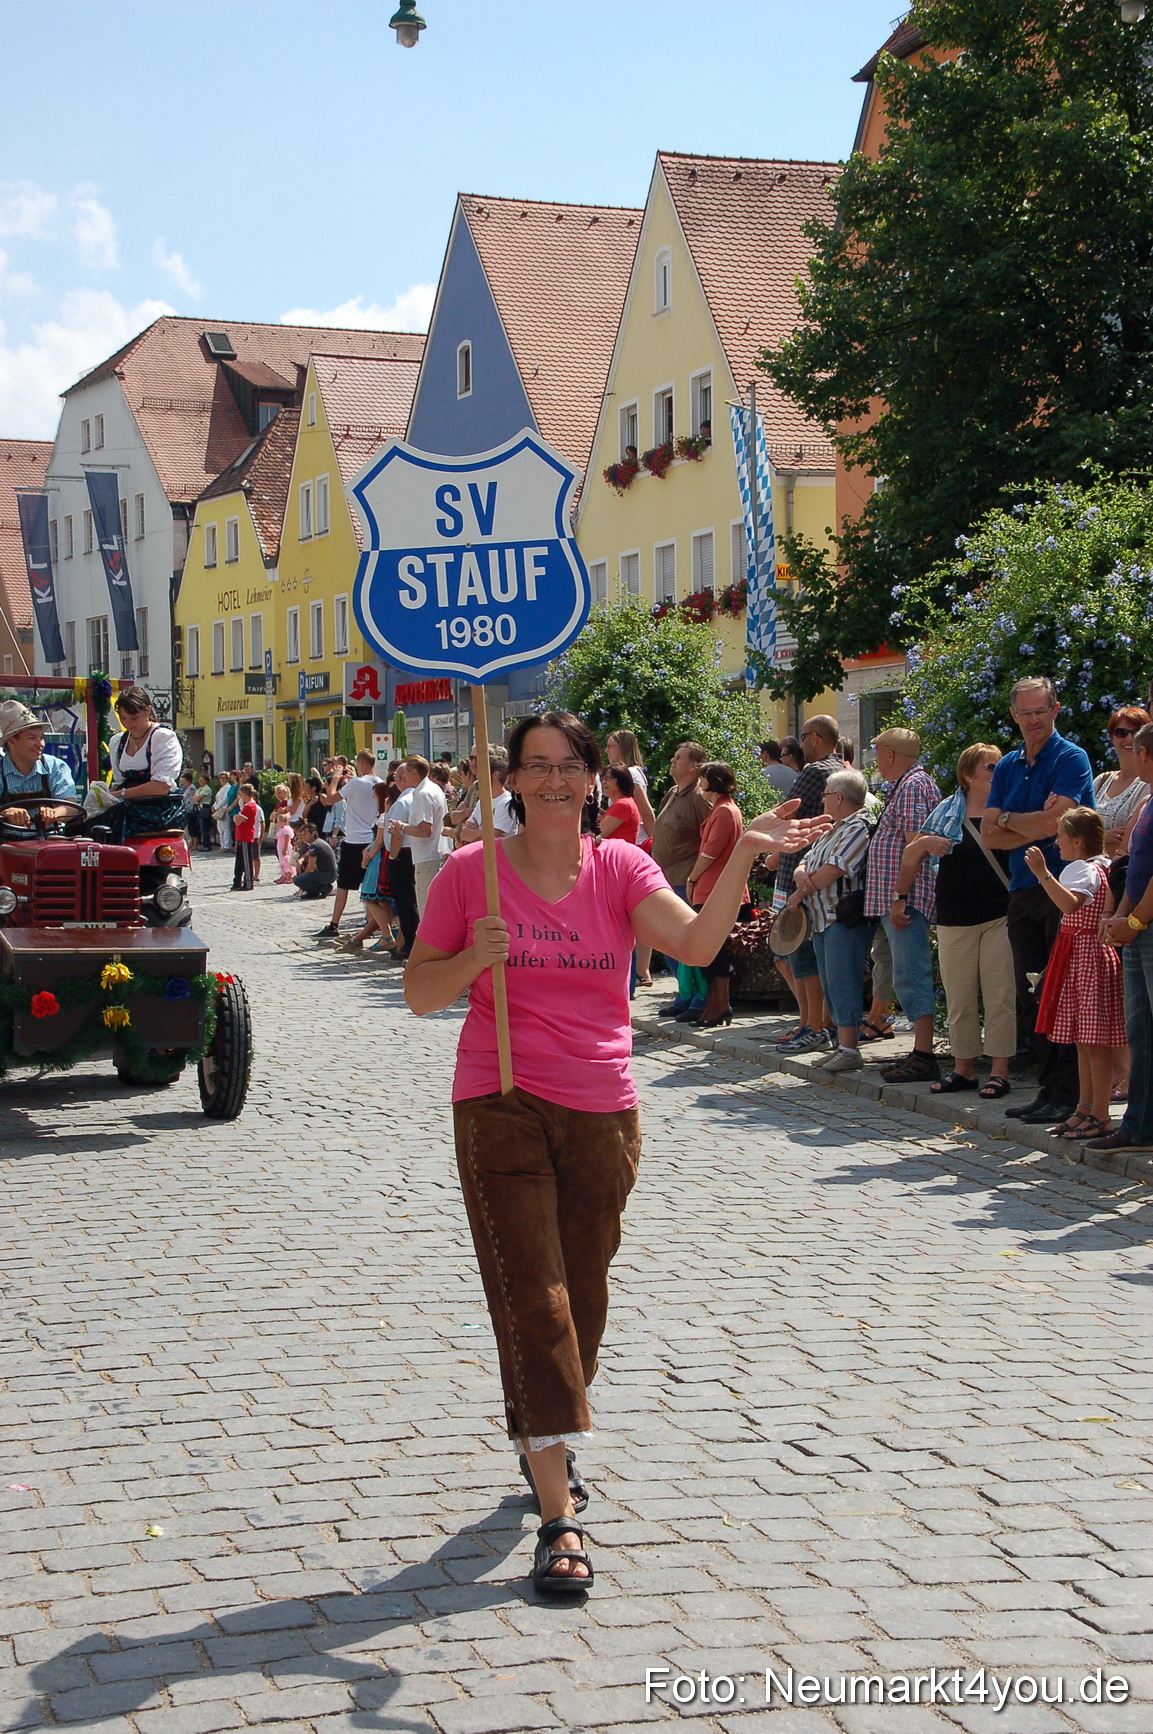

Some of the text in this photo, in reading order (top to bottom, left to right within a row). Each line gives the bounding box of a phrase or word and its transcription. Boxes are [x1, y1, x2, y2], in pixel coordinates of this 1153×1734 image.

[435, 481, 498, 538] SV
[397, 546, 549, 610] STAUF
[777, 566, 791, 577] KIN
[217, 589, 241, 612] HOTEL
[435, 613, 517, 650] 1980
[305, 675, 324, 690] AIFUN
[217, 697, 249, 712] Restaurant
[516, 923, 580, 942] I bin a
[506, 950, 617, 970] ufer Moidl
